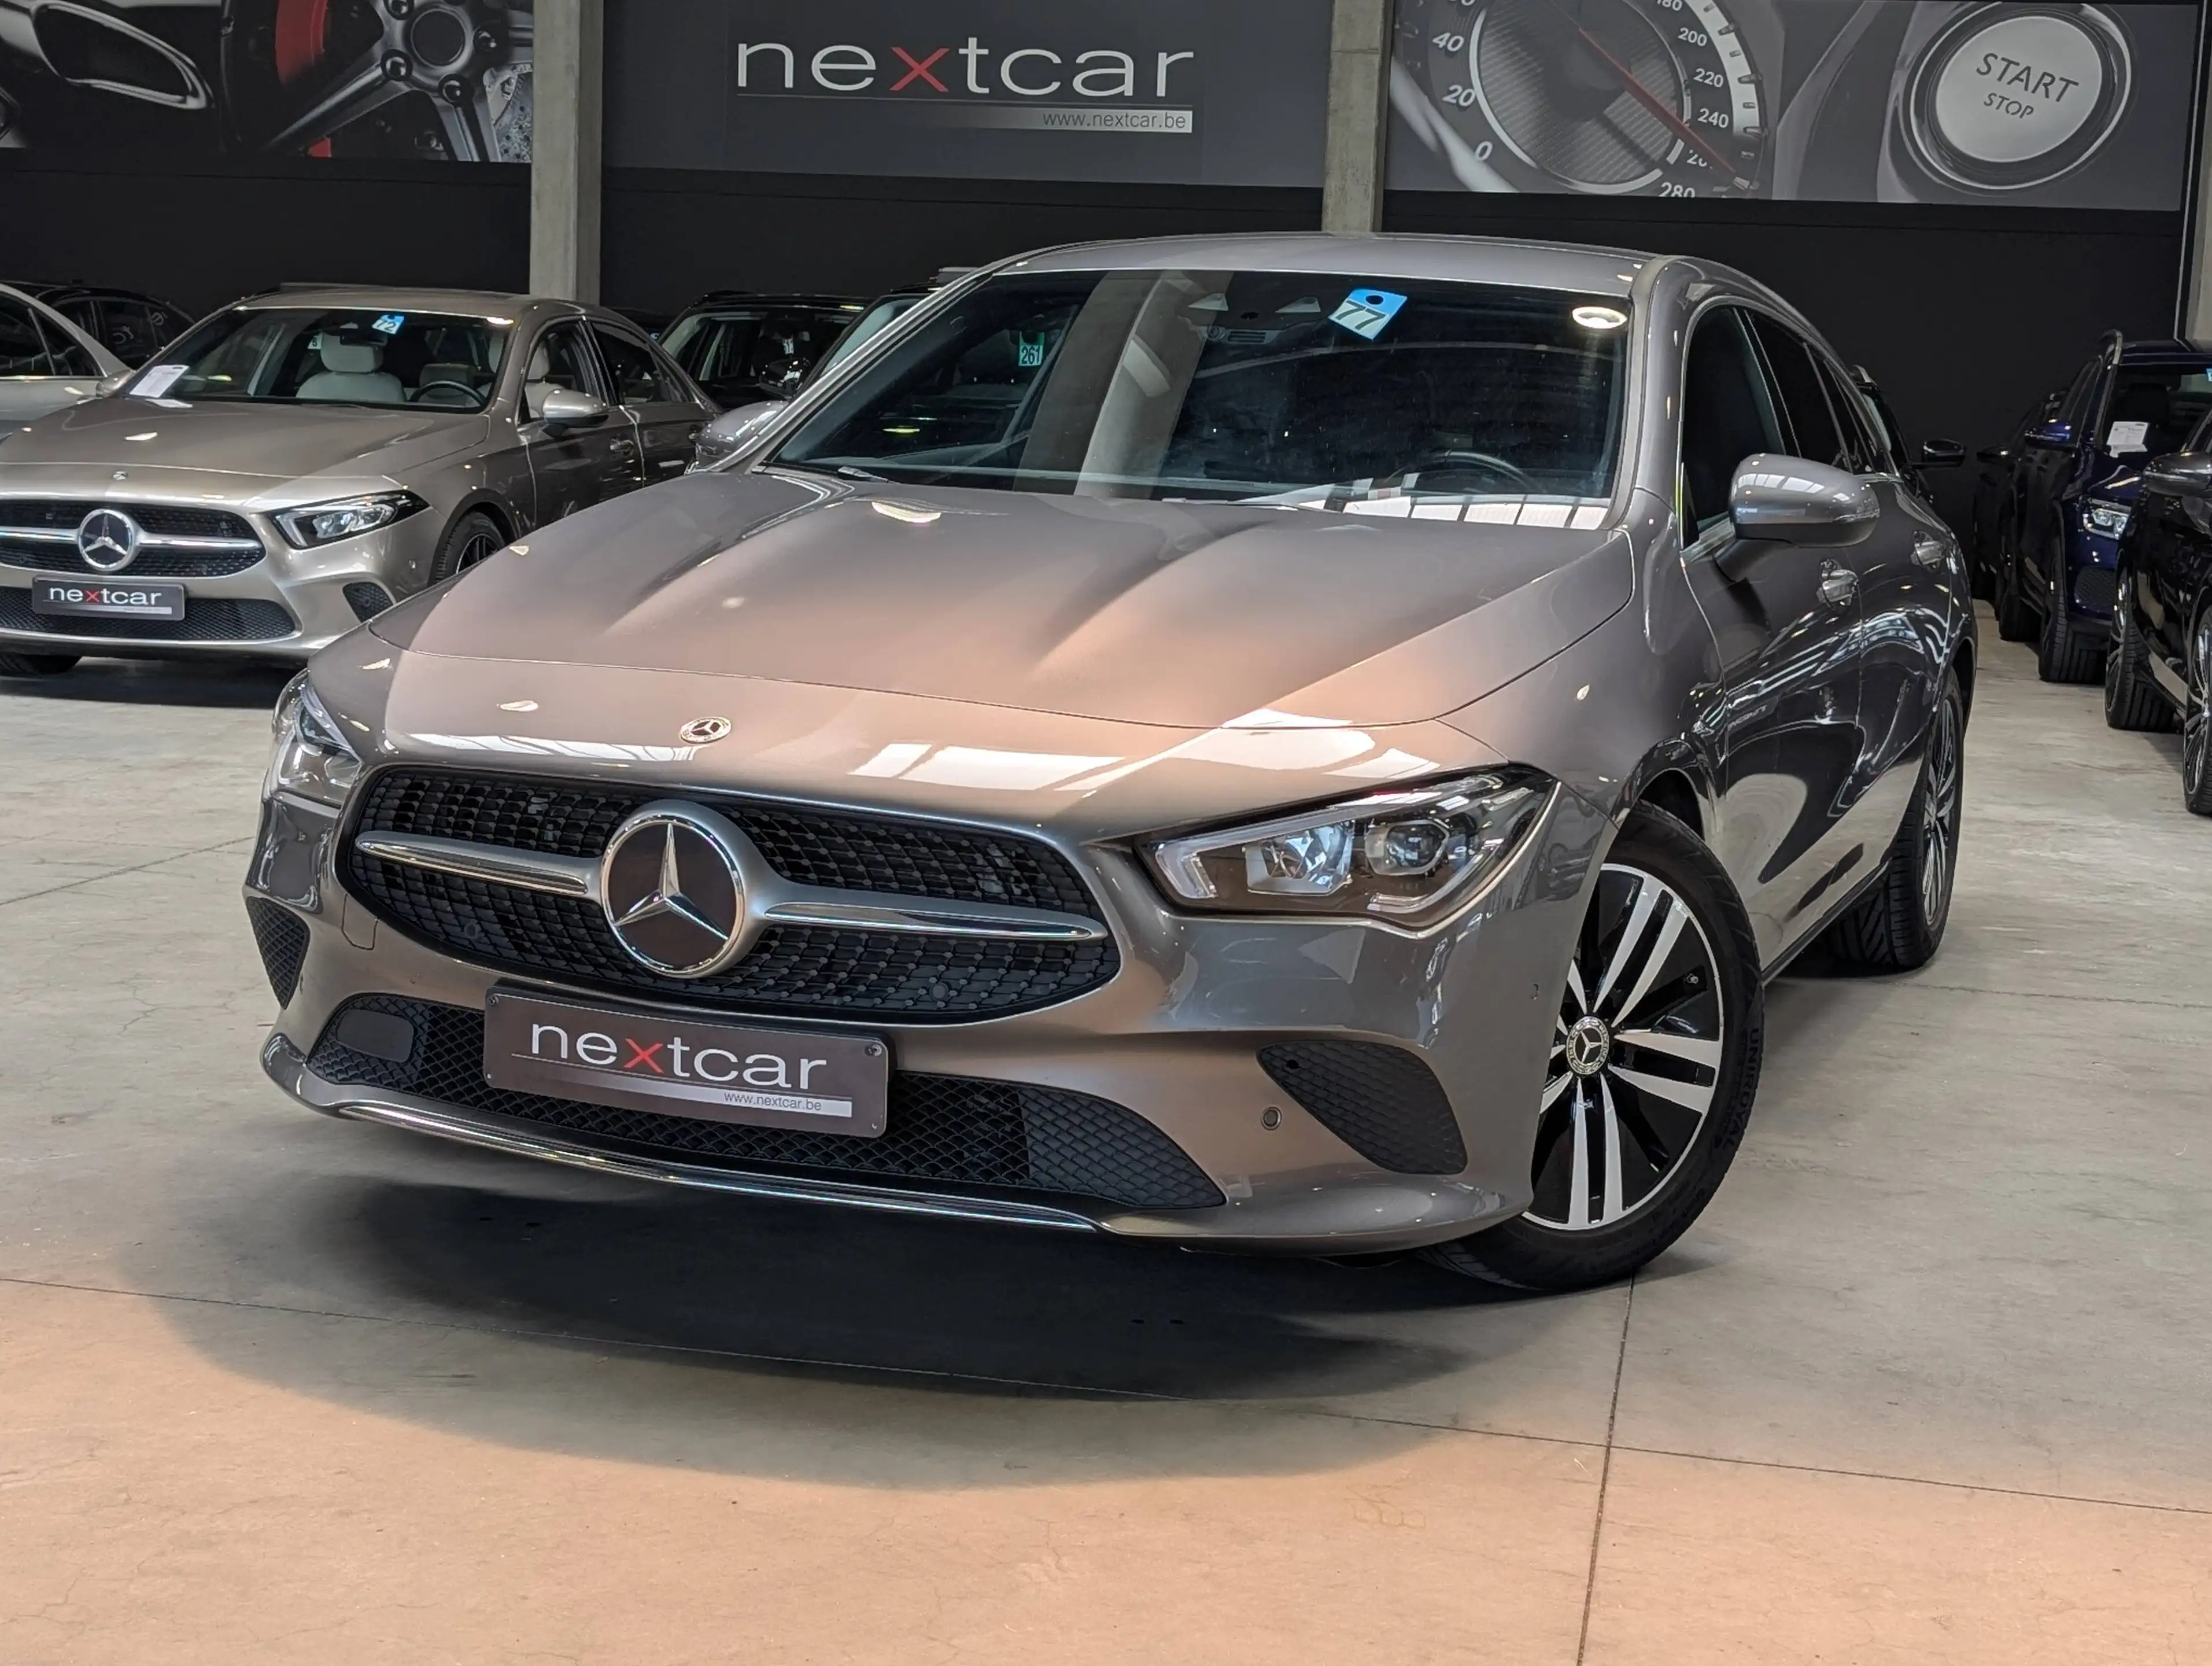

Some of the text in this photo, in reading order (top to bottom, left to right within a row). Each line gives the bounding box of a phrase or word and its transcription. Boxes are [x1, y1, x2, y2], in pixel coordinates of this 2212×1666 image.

[1432, 32, 1464, 51] 40
[1678, 27, 1707, 46] 200
[737, 36, 1194, 97] nextcar
[1693, 68, 1723, 87] 220
[1976, 53, 2080, 102] START
[1442, 84, 1475, 106] 20
[1984, 93, 2034, 119] STOP
[1043, 112, 1186, 128] www.nextcar.be
[1698, 108, 1729, 128] 240
[1475, 141, 1493, 161] 0
[1659, 182, 1696, 198] 280
[1335, 300, 1386, 330] 77
[1021, 346, 1040, 364] 261
[49, 587, 162, 606] nextcar
[531, 1023, 826, 1090] nextcar
[1722, 1028, 1759, 1149] UNIROYAL
[723, 1093, 822, 1111] www.nextcar.be
